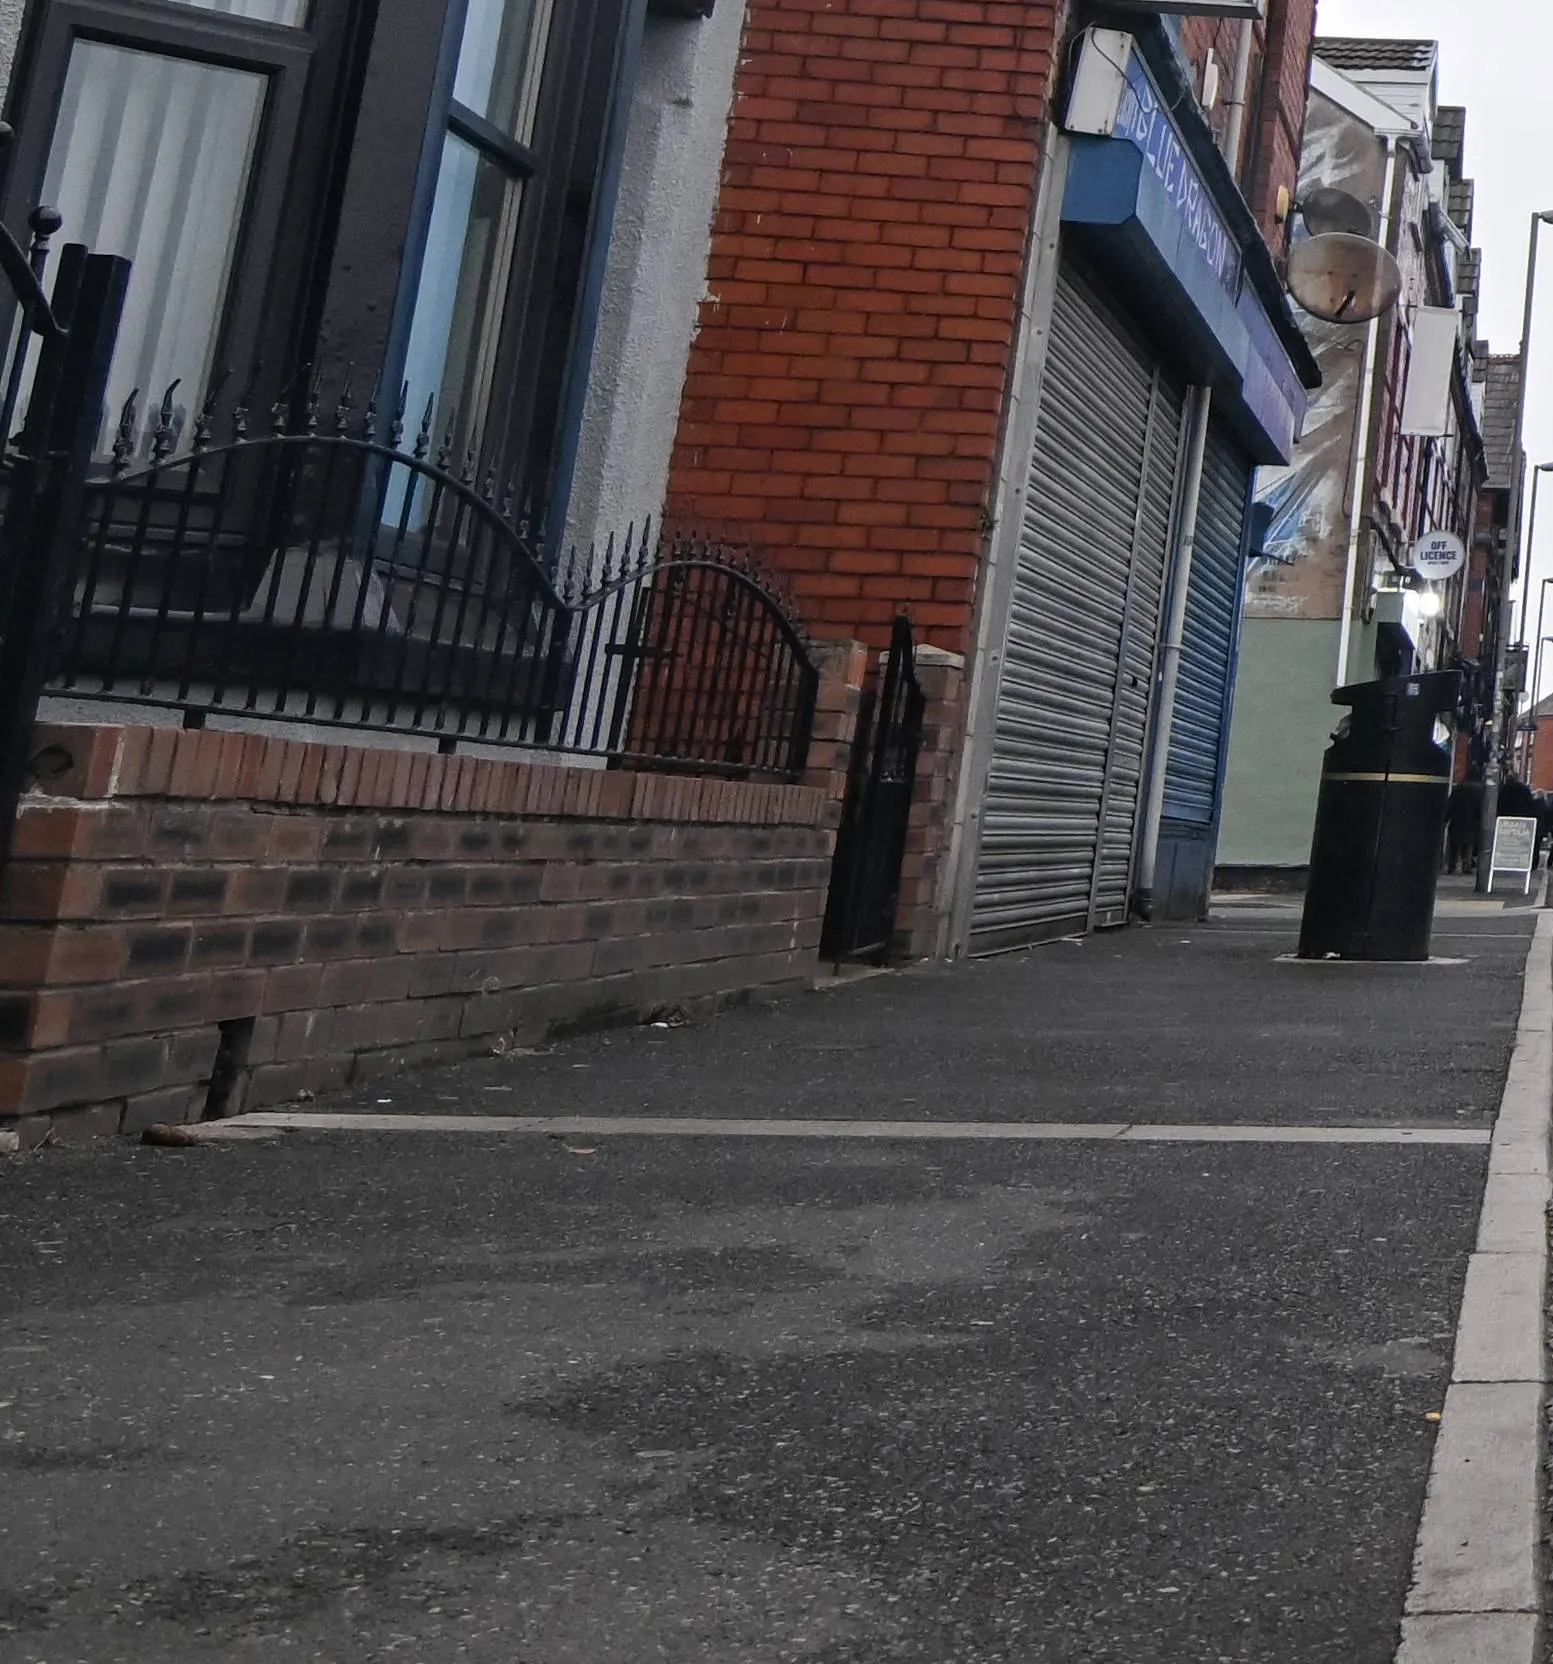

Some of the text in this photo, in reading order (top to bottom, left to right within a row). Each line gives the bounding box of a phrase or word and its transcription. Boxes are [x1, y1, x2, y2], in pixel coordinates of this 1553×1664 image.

[1136, 83, 1228, 278] BLUE DRAGON
[1430, 540, 1447, 550] OFF
[1420, 551, 1457, 560] LICENCE
